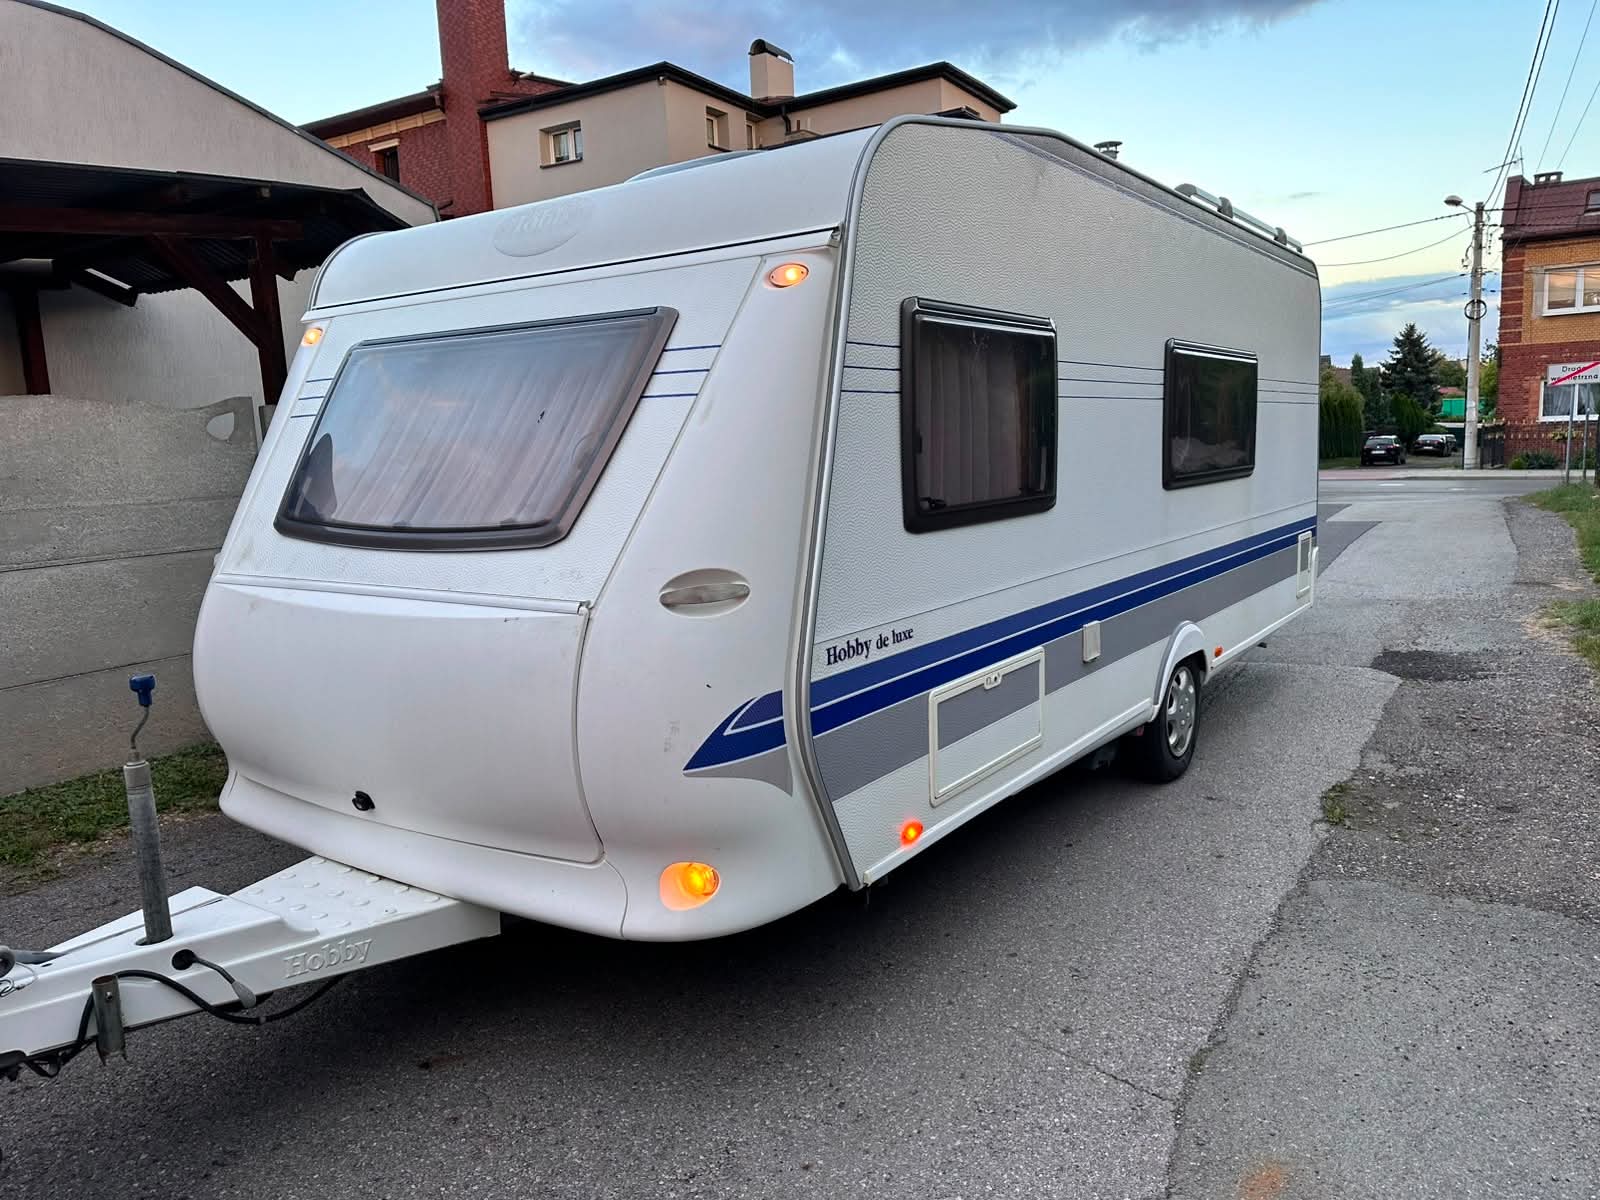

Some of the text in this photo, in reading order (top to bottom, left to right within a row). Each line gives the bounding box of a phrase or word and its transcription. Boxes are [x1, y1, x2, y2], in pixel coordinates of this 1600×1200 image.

[826, 628, 914, 666] Hobby de luxe
[283, 939, 372, 979] Hobby
